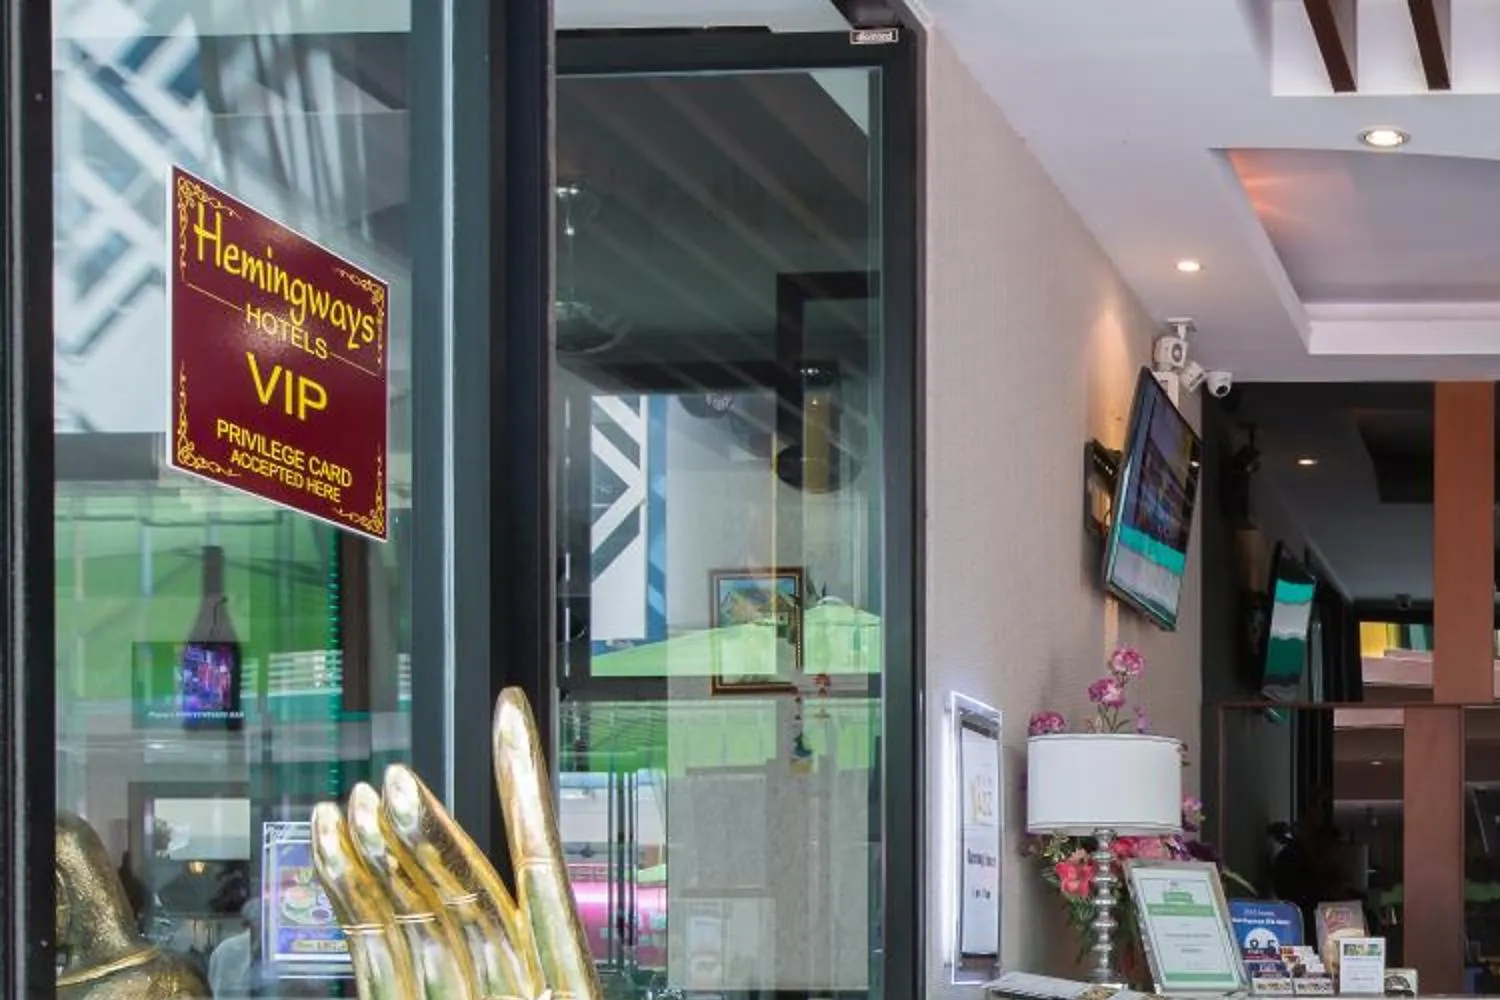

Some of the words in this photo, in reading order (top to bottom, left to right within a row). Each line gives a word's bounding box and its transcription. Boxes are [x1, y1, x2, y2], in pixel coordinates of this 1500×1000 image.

[193, 201, 375, 349] Hemingways
[246, 303, 329, 360] HOTELS
[246, 351, 328, 421] VIP
[216, 419, 305, 472] PRIVILEGE
[308, 456, 353, 488] CARD
[230, 449, 304, 490] ACCEPTED
[307, 477, 341, 503] HERE
